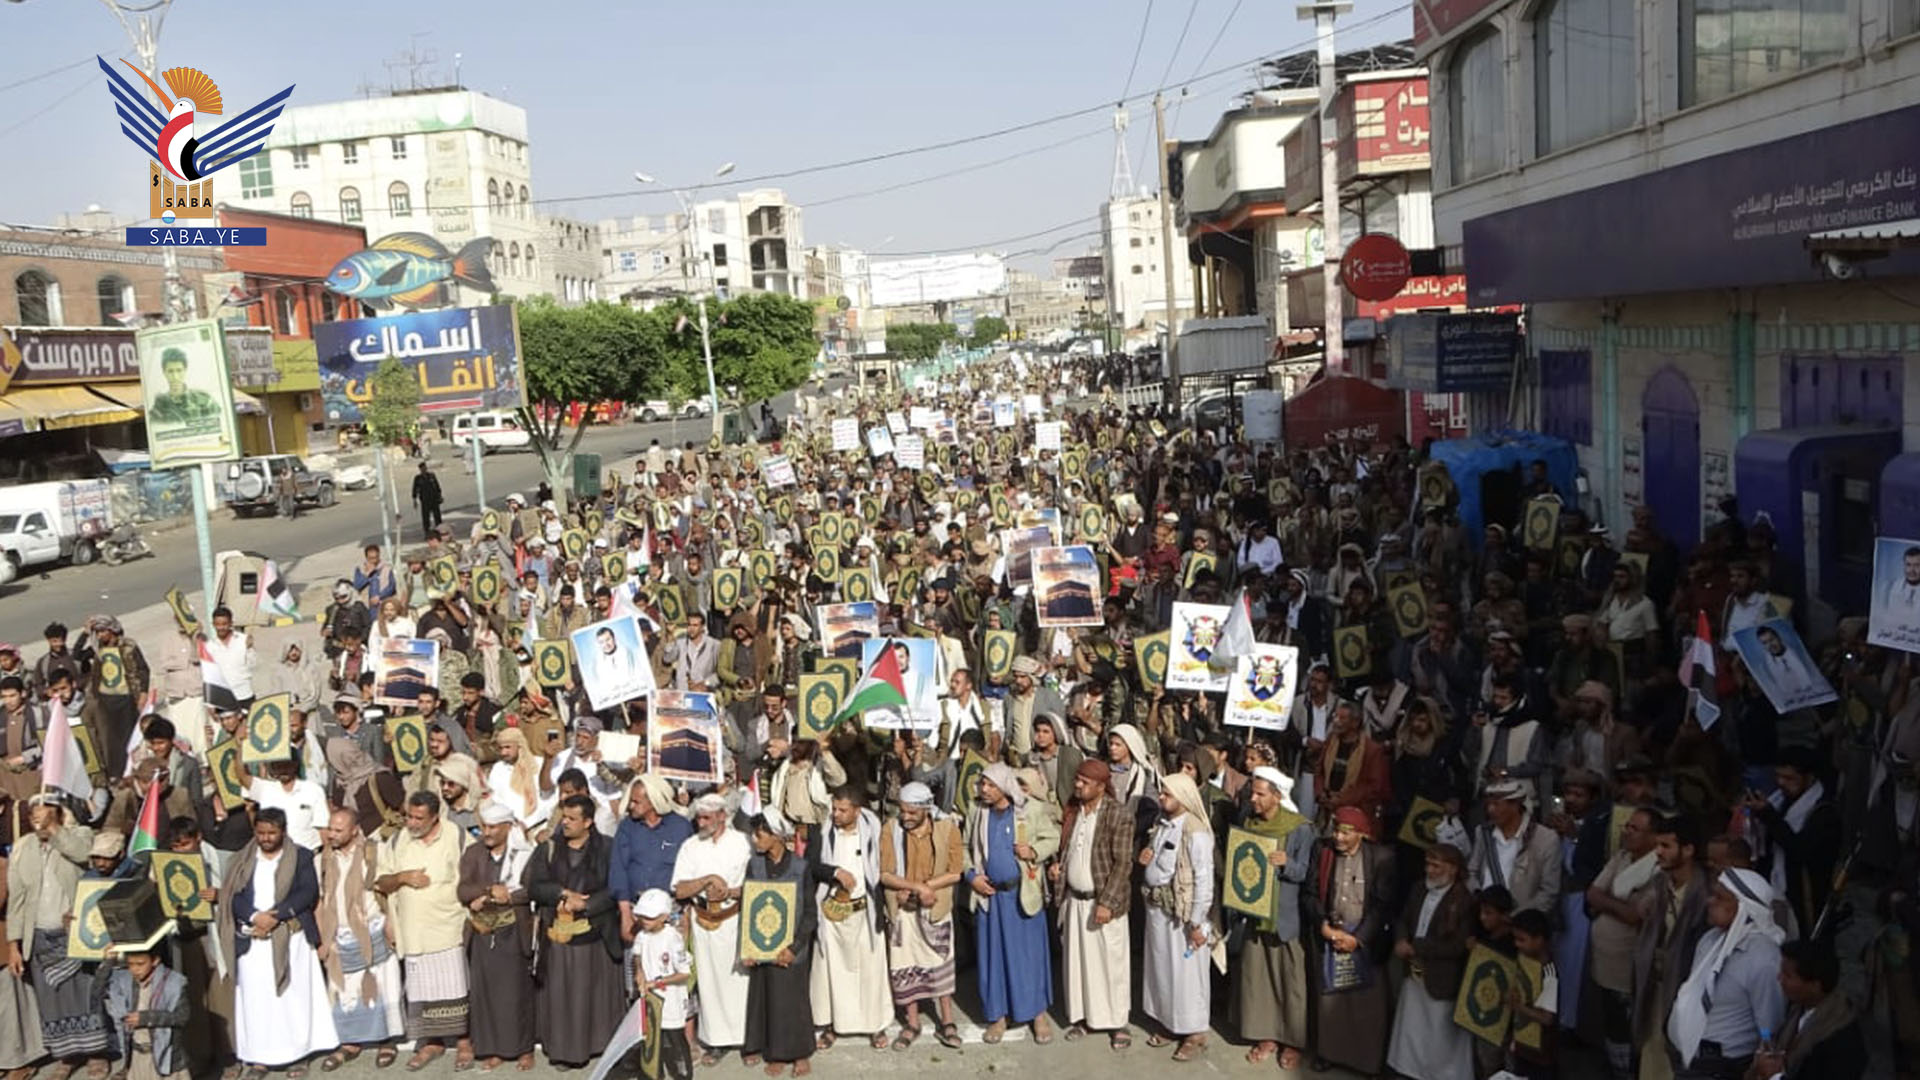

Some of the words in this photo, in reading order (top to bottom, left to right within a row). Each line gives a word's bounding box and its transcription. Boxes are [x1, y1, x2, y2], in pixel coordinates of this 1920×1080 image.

[1398, 85, 1429, 112] ام
[1397, 120, 1430, 147] وت
[1846, 170, 1891, 203] الكريمي
[1893, 168, 1917, 190] بنك
[1886, 200, 1916, 219] BANK
[350, 310, 482, 362] أسماك
[22, 337, 115, 375] وبروست
[346, 354, 496, 409] القاي
